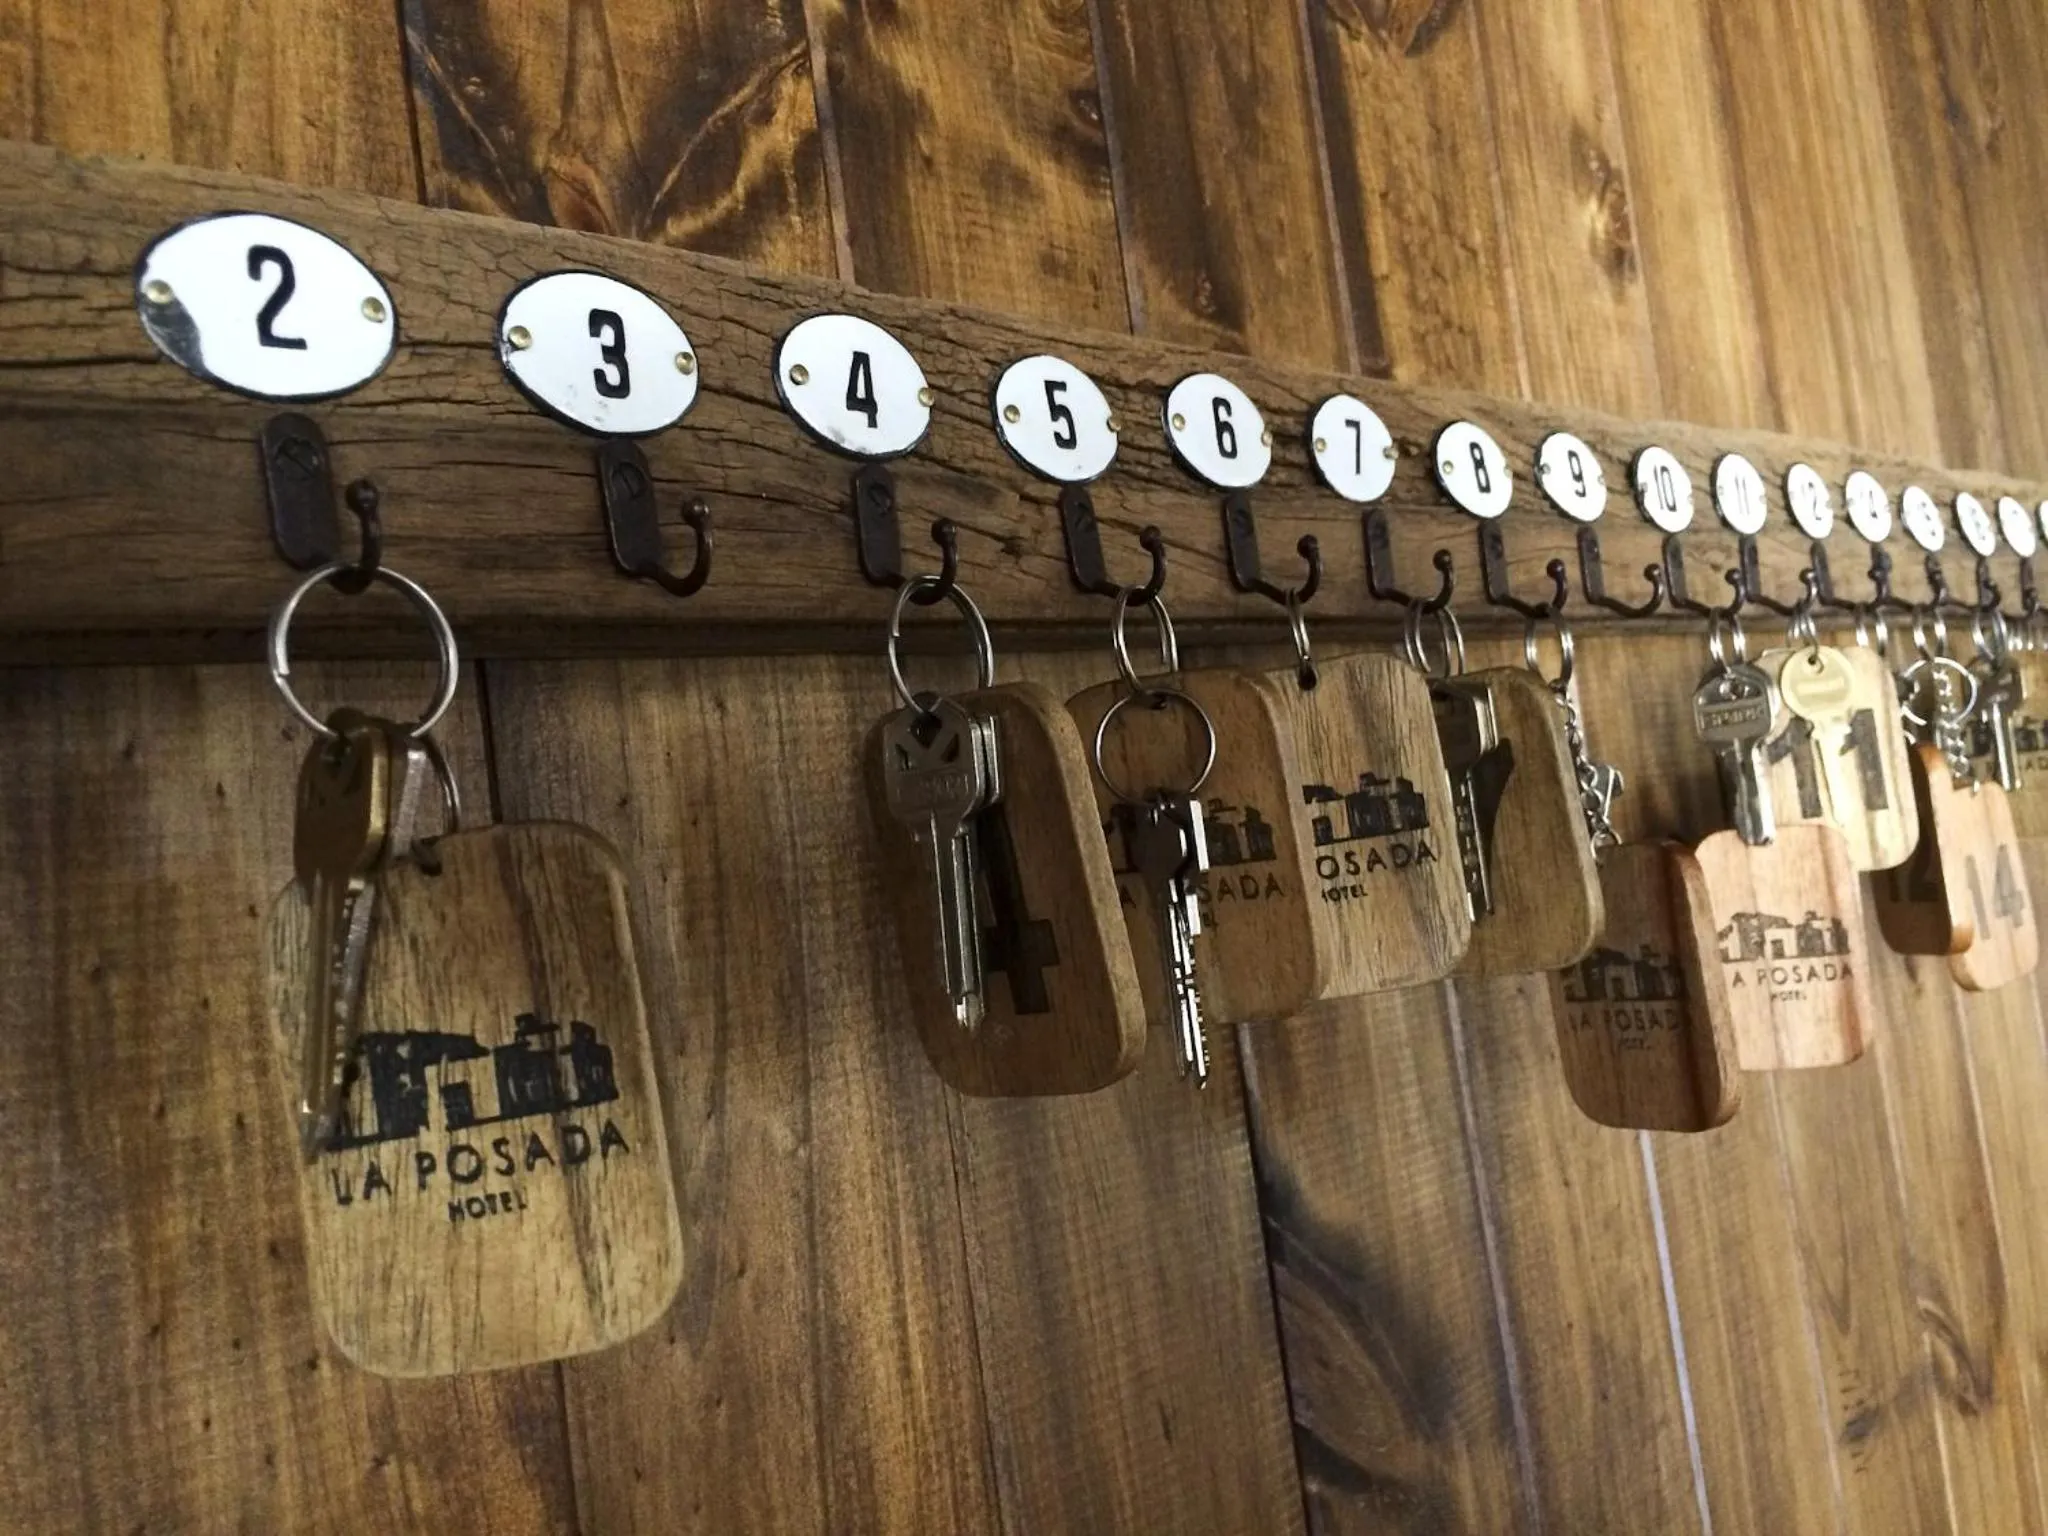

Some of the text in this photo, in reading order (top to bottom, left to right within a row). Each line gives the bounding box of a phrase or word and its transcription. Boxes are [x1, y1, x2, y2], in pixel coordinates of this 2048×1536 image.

[246, 244, 308, 351] 2
[588, 308, 631, 399] 3
[845, 350, 878, 429] 4
[1043, 380, 1077, 449] 5
[1211, 396, 1238, 459] 6
[1344, 418, 1361, 475] 7
[1469, 441, 1491, 494] 8
[1567, 449, 1587, 498] 9
[1653, 464, 1677, 512] 10
[1734, 473, 1750, 515] 11
[1766, 708, 1889, 820] 11
[1315, 838, 1438, 881] OSADA
[1965, 843, 2024, 941] 14
[1756, 961, 1853, 986] POSADA
[330, 1117, 630, 1205] LA POSADA
[447, 1188, 530, 1223] HOTEL
